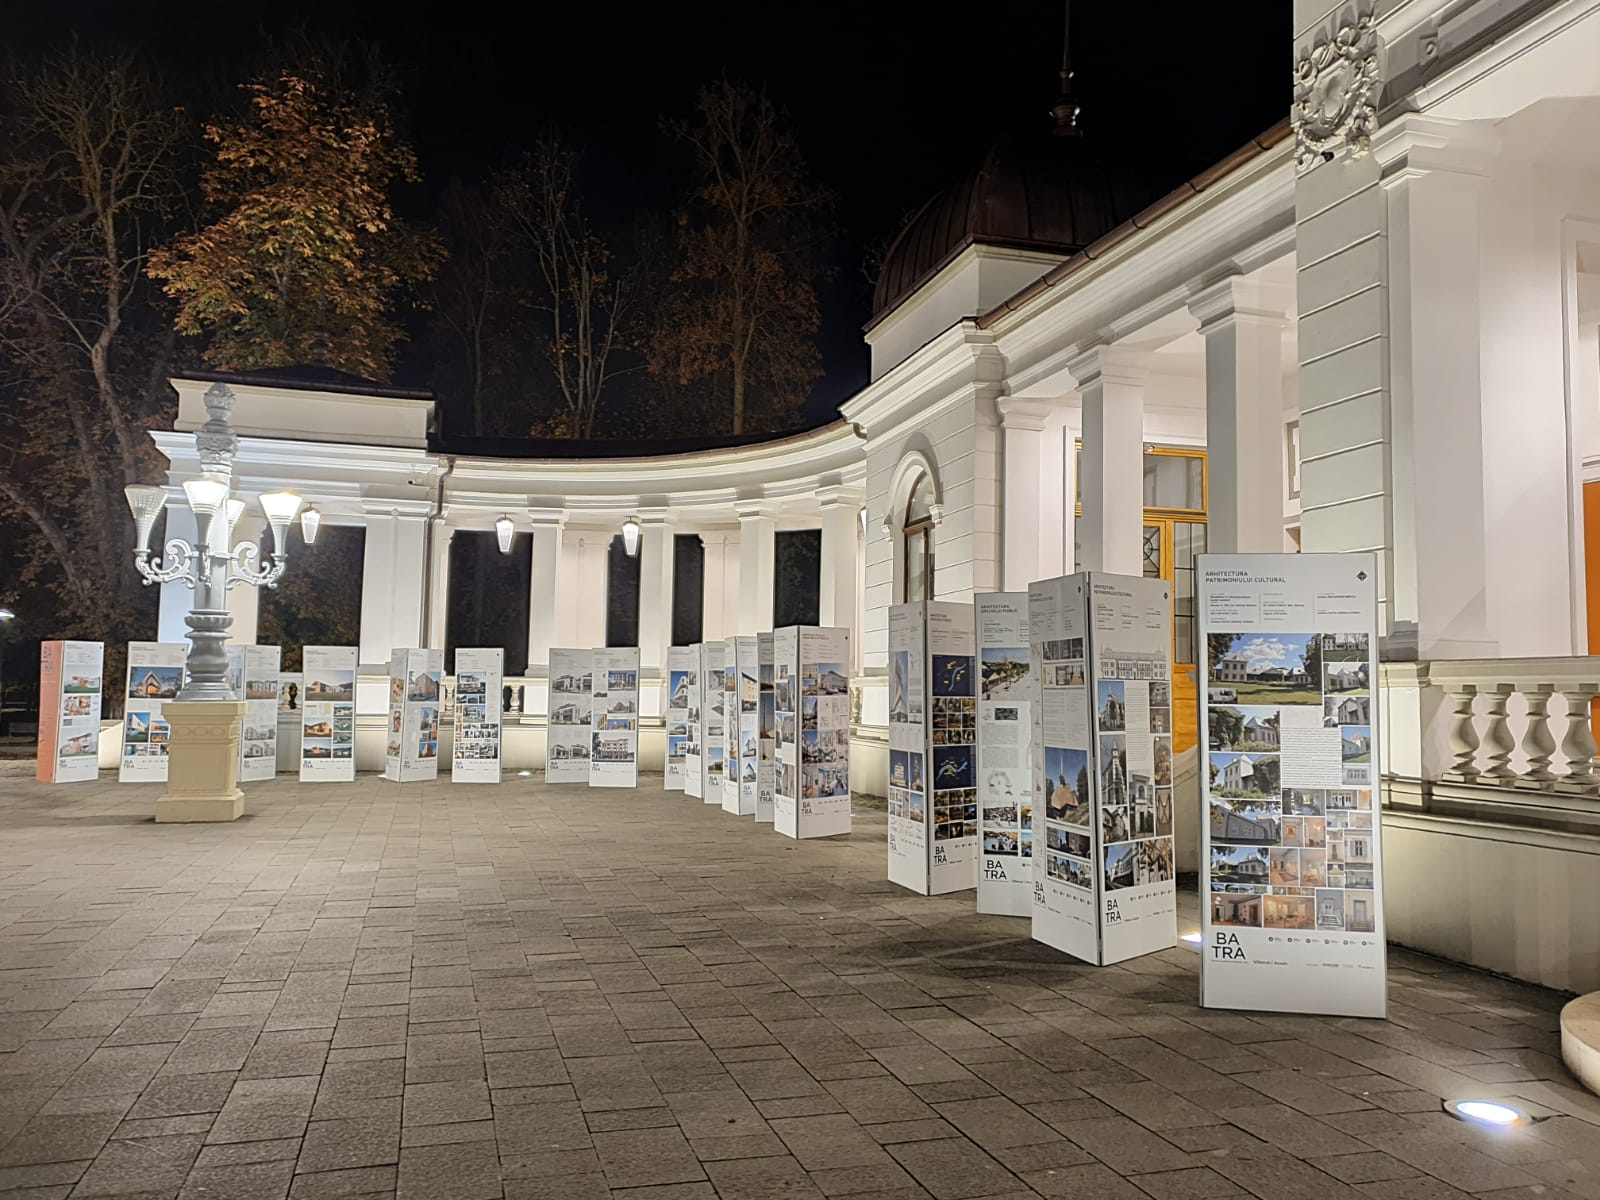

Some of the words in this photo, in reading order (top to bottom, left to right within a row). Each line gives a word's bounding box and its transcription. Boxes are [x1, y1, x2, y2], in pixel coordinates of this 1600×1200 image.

[935, 846, 945, 855] BA
[933, 855, 948, 864] TRA
[986, 860, 1003, 869] BA
[984, 869, 1007, 880] TRA
[1035, 880, 1044, 893] BA
[1033, 891, 1047, 905] TRA
[1107, 898, 1119, 911] BA
[1105, 911, 1122, 923] TRA
[1216, 932, 1240, 945] BA
[1211, 945, 1246, 960] TRA
